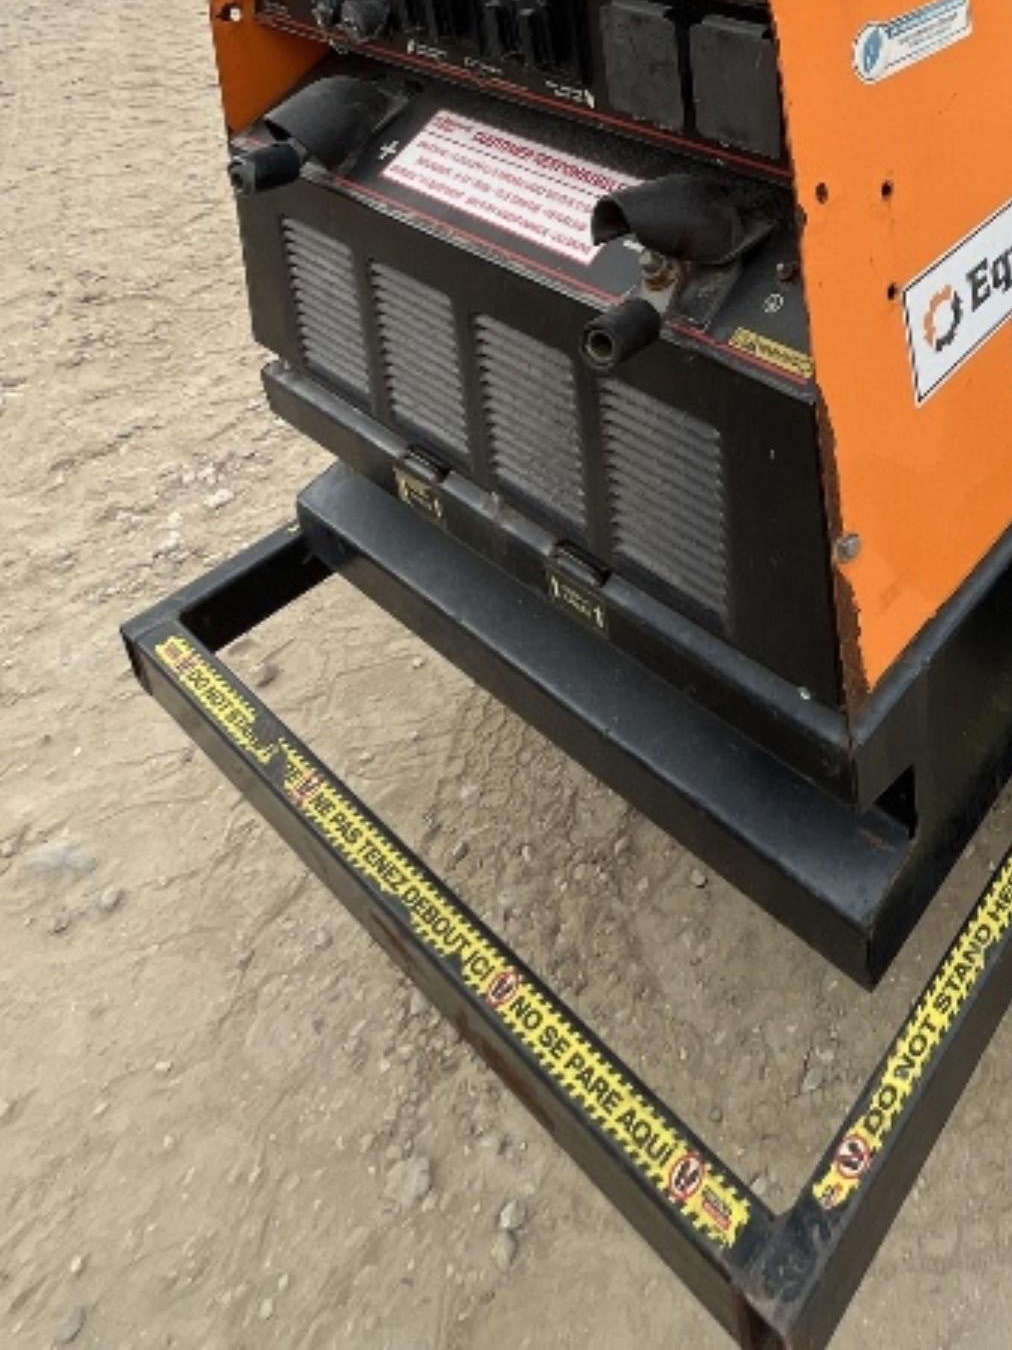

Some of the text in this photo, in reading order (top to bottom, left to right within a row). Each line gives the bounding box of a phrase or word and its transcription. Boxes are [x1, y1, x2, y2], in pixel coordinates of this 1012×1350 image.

[309, 793, 336, 817] NE
[329, 811, 363, 844] PAS
[359, 839, 409, 891] TENEZ
[401, 885, 471, 951] DEBOUT
[508, 995, 544, 1031] NO
[538, 1025, 571, 1059] SE
[563, 1052, 624, 1116] PARE
[863, 1084, 898, 1138] DO
[893, 1014, 940, 1082] NOT
[936, 924, 993, 1016] STAND
